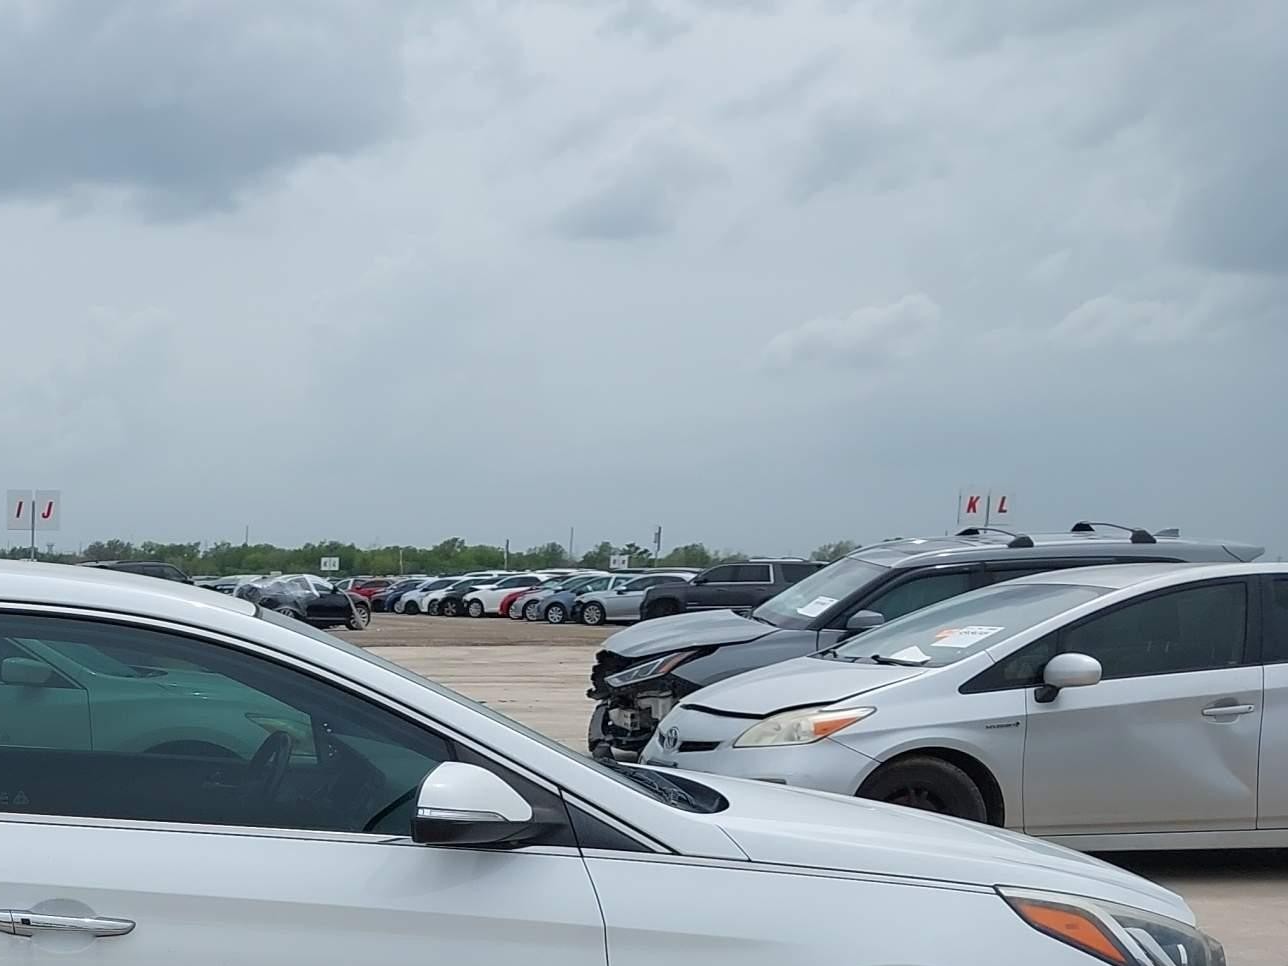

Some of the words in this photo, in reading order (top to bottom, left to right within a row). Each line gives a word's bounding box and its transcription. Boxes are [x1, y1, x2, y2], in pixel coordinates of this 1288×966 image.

[42, 501, 53, 518] J
[967, 496, 981, 513] K
[998, 496, 1007, 513] L
